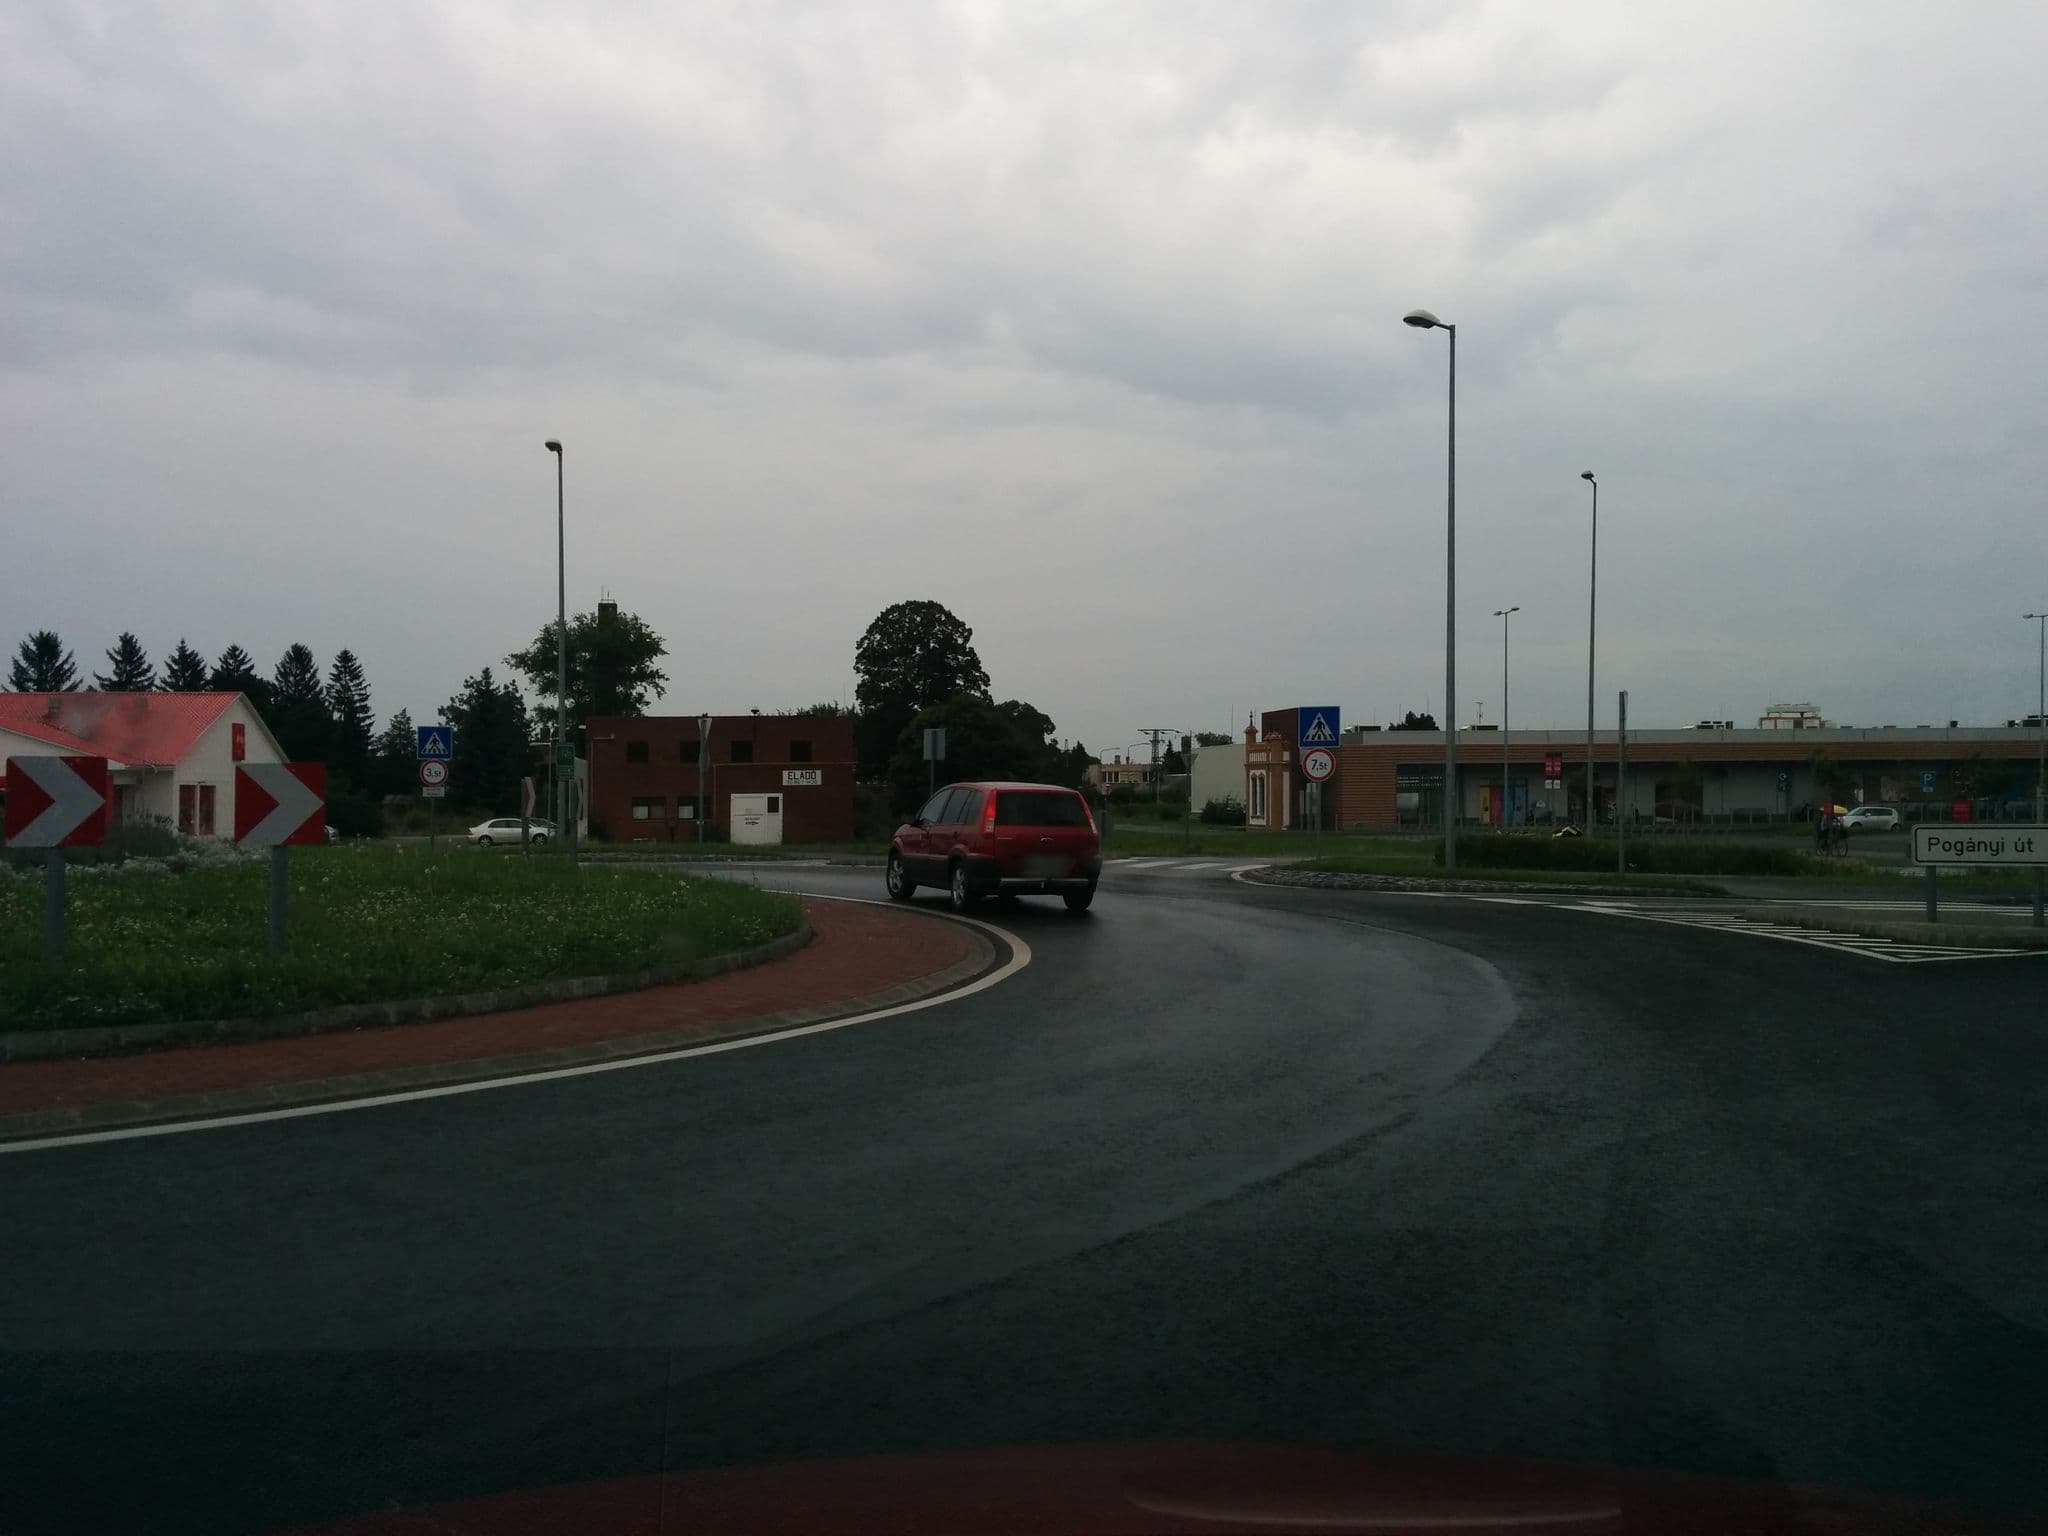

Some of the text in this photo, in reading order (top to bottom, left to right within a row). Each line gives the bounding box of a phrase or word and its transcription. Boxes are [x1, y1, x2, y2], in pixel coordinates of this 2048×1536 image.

[1311, 759, 1328, 771] 7,5t
[1927, 837, 2034, 857] Pogányi út
